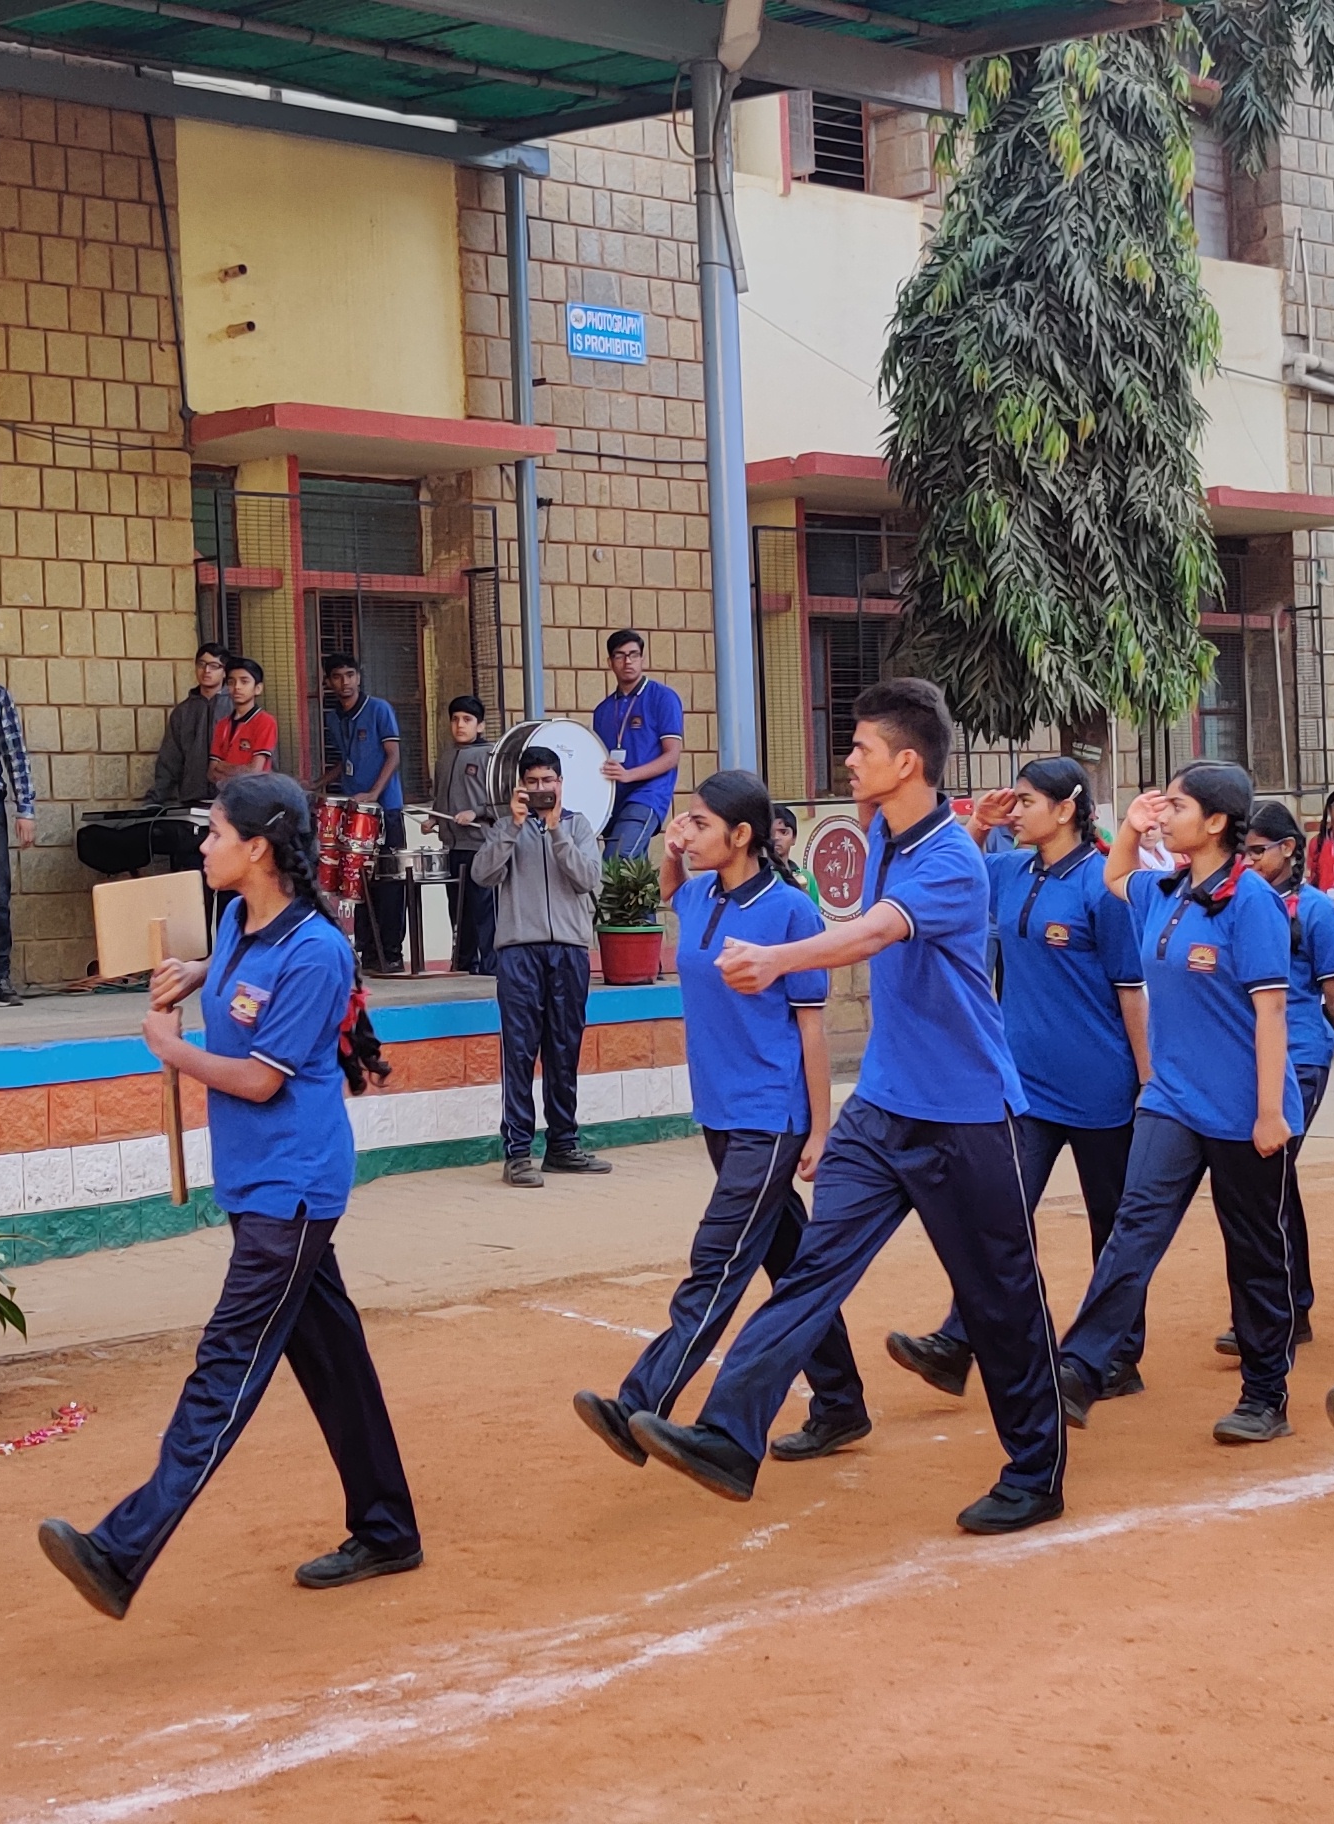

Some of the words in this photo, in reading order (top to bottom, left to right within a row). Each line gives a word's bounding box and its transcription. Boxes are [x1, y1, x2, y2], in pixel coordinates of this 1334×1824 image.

[586, 311, 641, 336] PHOTOGRAPHY
[572, 332, 584, 351] IS
[585, 334, 642, 358] PROHIBITED
